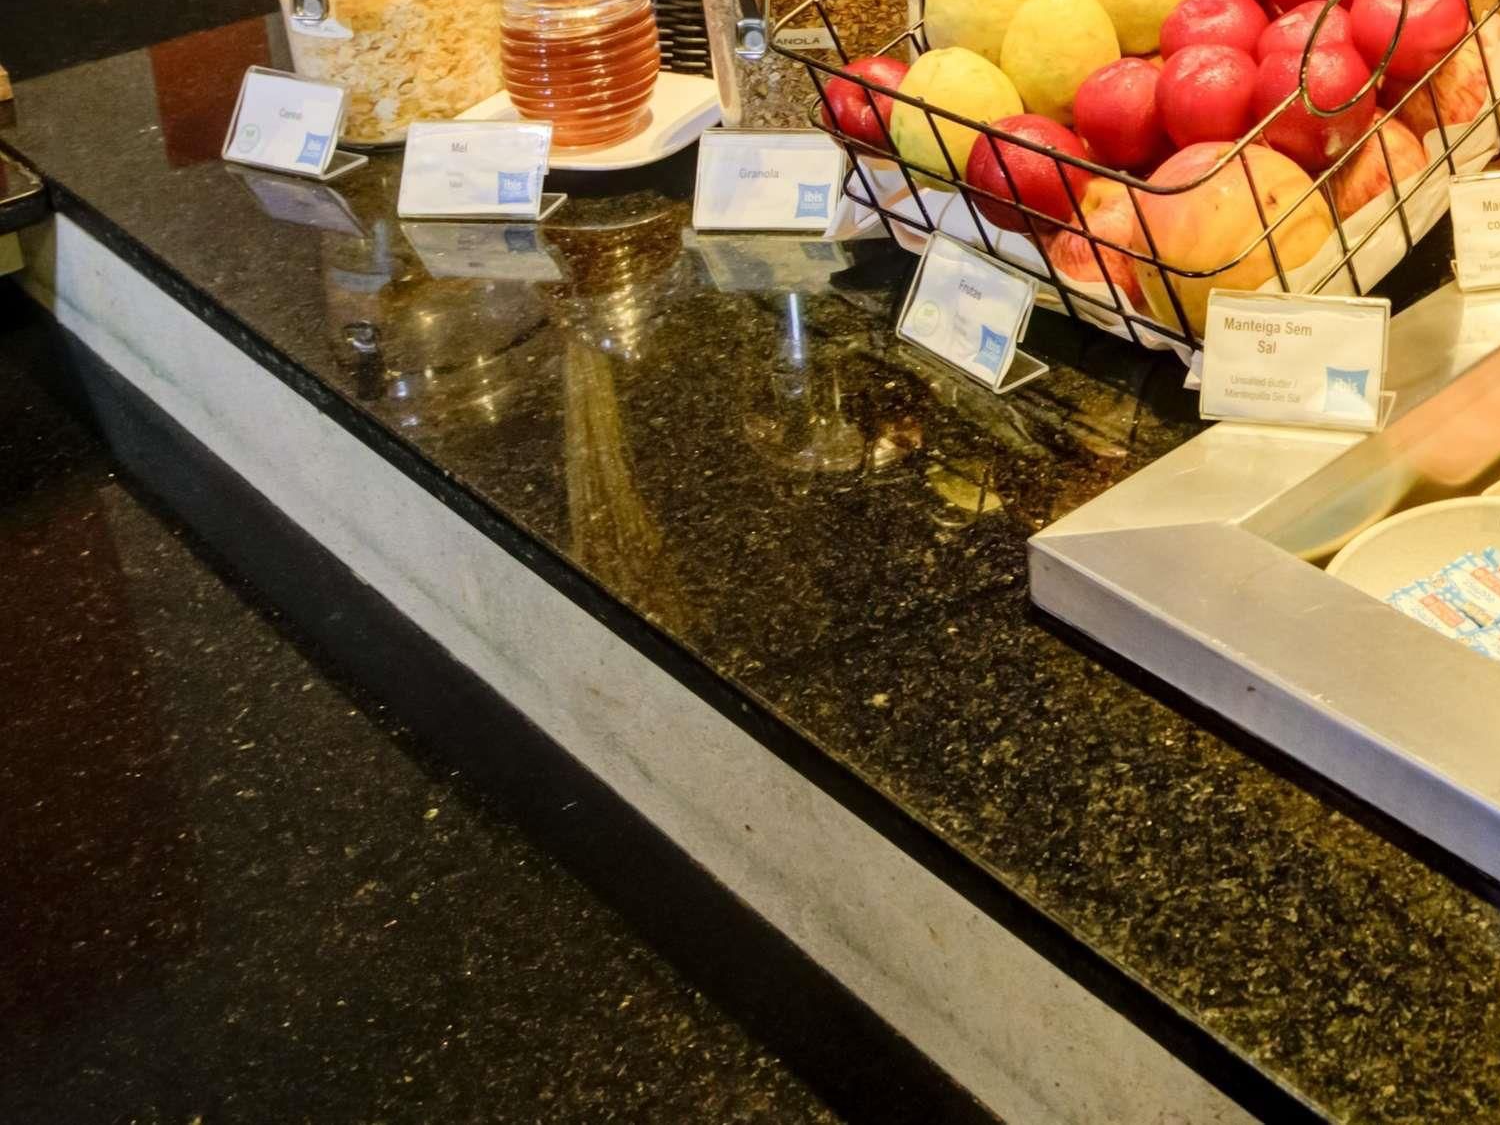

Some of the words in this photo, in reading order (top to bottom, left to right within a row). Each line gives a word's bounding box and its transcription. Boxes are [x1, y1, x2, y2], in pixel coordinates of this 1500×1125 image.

[776, 37, 820, 45] ANOLA
[739, 167, 780, 179] Granola
[1224, 316, 1281, 336] Manteiga
[1285, 321, 1313, 336] Sem
[1257, 340, 1278, 355] Sal
